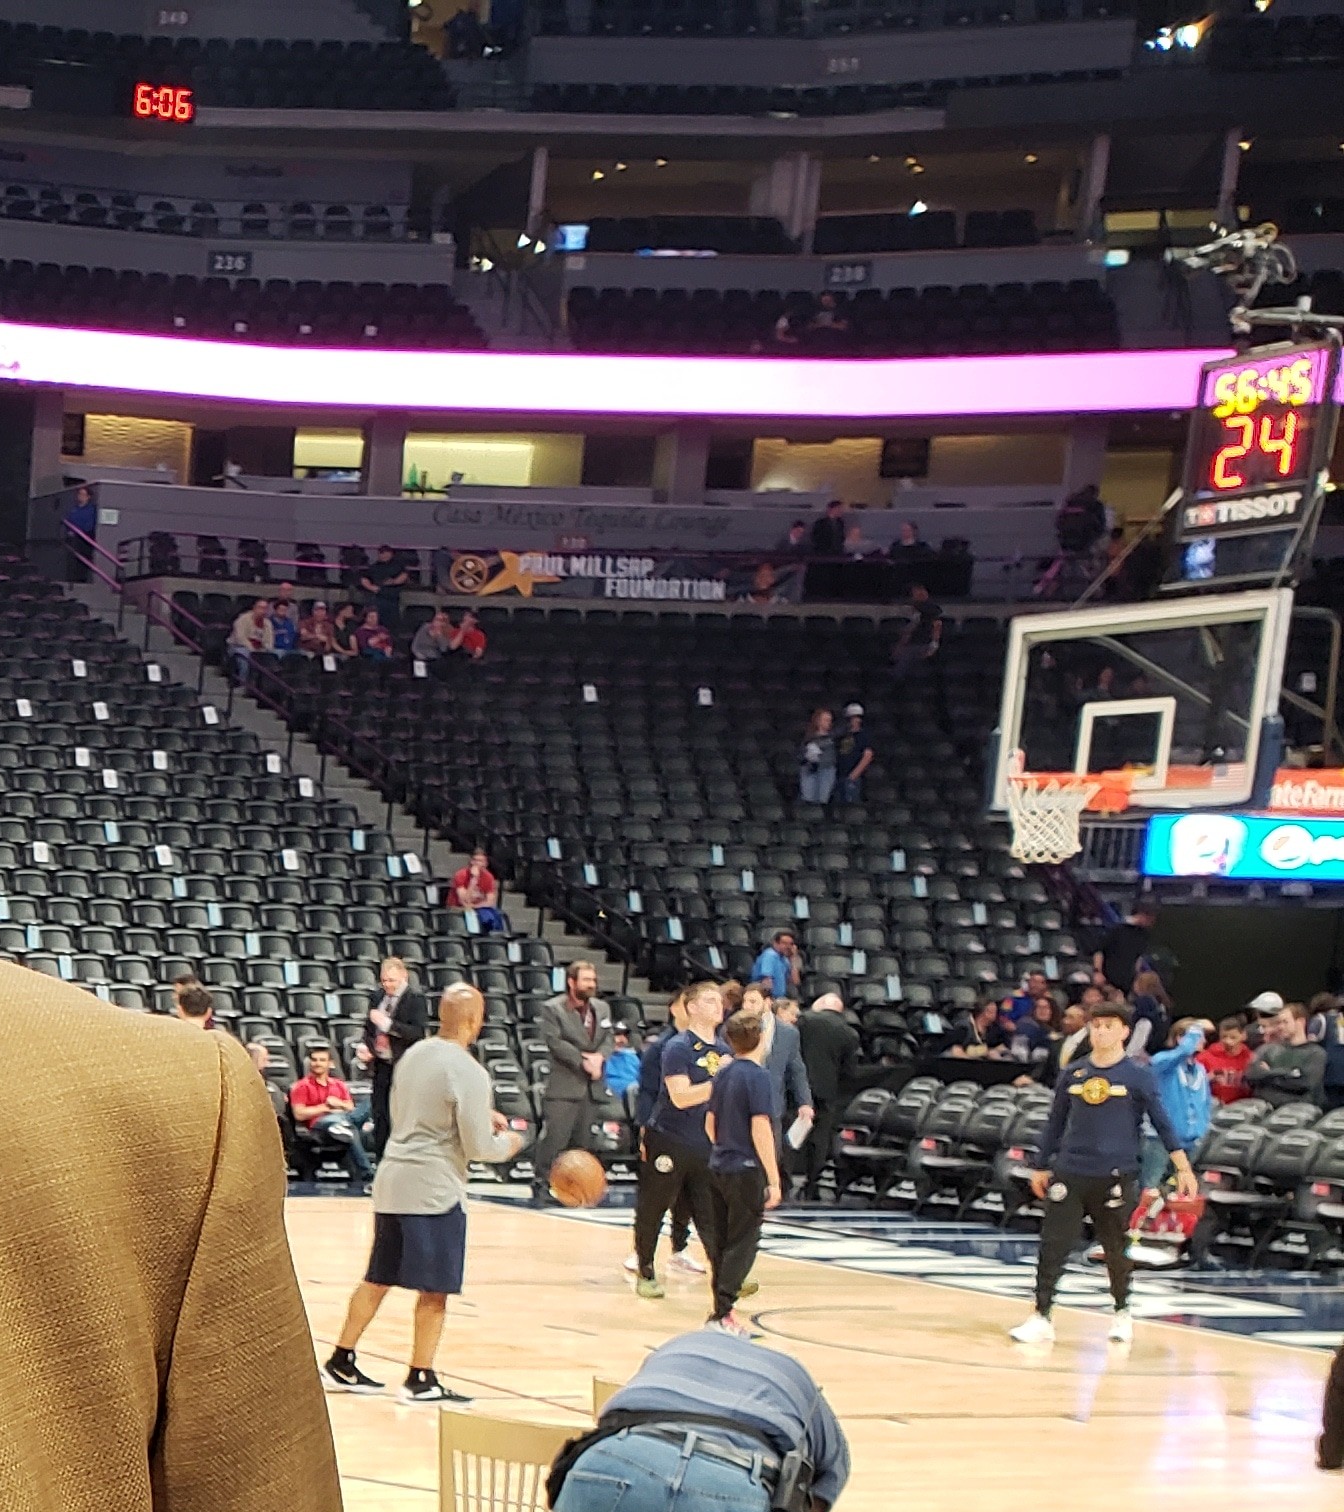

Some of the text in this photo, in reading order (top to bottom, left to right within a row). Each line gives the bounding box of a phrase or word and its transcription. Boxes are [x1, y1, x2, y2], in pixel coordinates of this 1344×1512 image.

[135, 83, 194, 121] 6:06
[1213, 358, 1313, 418] 56:45
[1213, 410, 1298, 489] 24
[1216, 491, 1302, 523] TISSOT
[518, 554, 654, 578] PAUL MILLSAP
[605, 577, 726, 600] FOUNDATION
